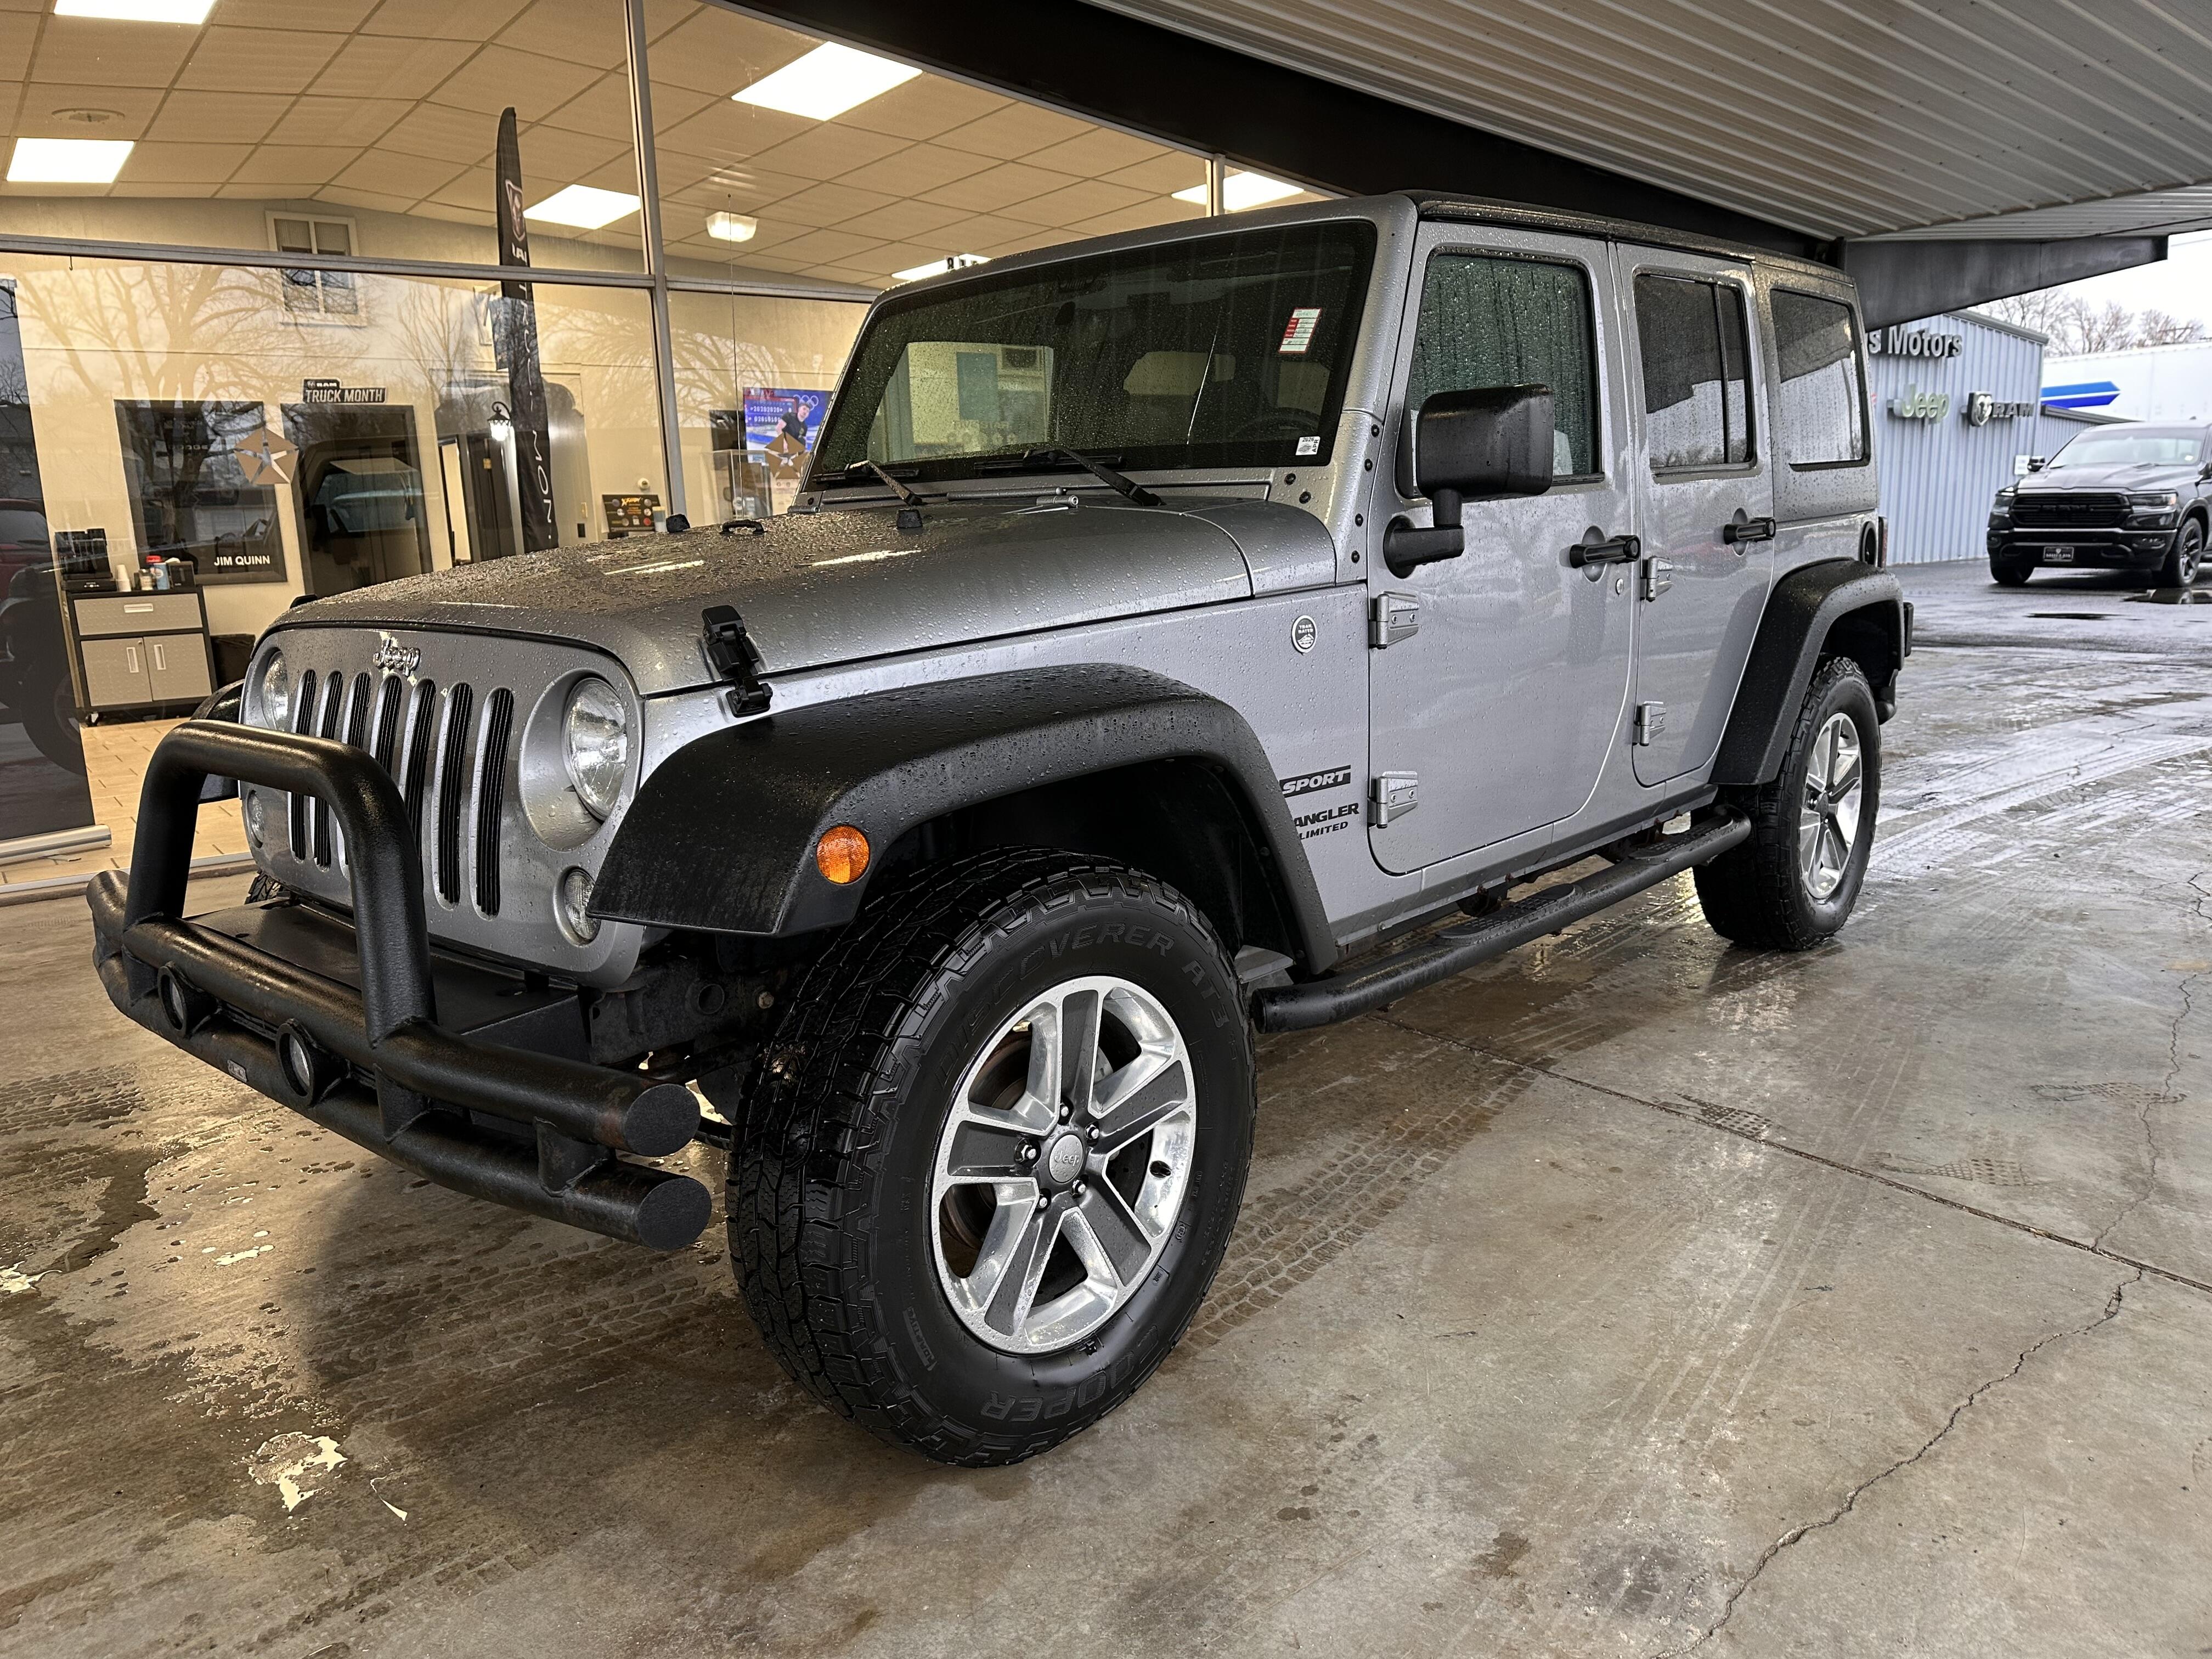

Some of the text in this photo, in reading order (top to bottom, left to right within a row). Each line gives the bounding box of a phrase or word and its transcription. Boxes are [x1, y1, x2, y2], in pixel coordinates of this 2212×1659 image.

[1888, 326, 1962, 357] Motors
[305, 388, 382, 403] TRUCK MONTH
[1902, 383, 1949, 424] Jeep
[1992, 402, 2034, 418] RAM
[214, 555, 270, 566] JIM QUINN
[372, 639, 421, 676] Jeep
[1282, 769, 1351, 795] SPORT
[1294, 802, 1360, 827] ANGLER
[1299, 821, 1348, 840] LIMITED
[935, 922, 1176, 1090] DISCOVERER
[1181, 960, 1230, 1028] AT3
[1054, 1150, 1080, 1167] Jeep
